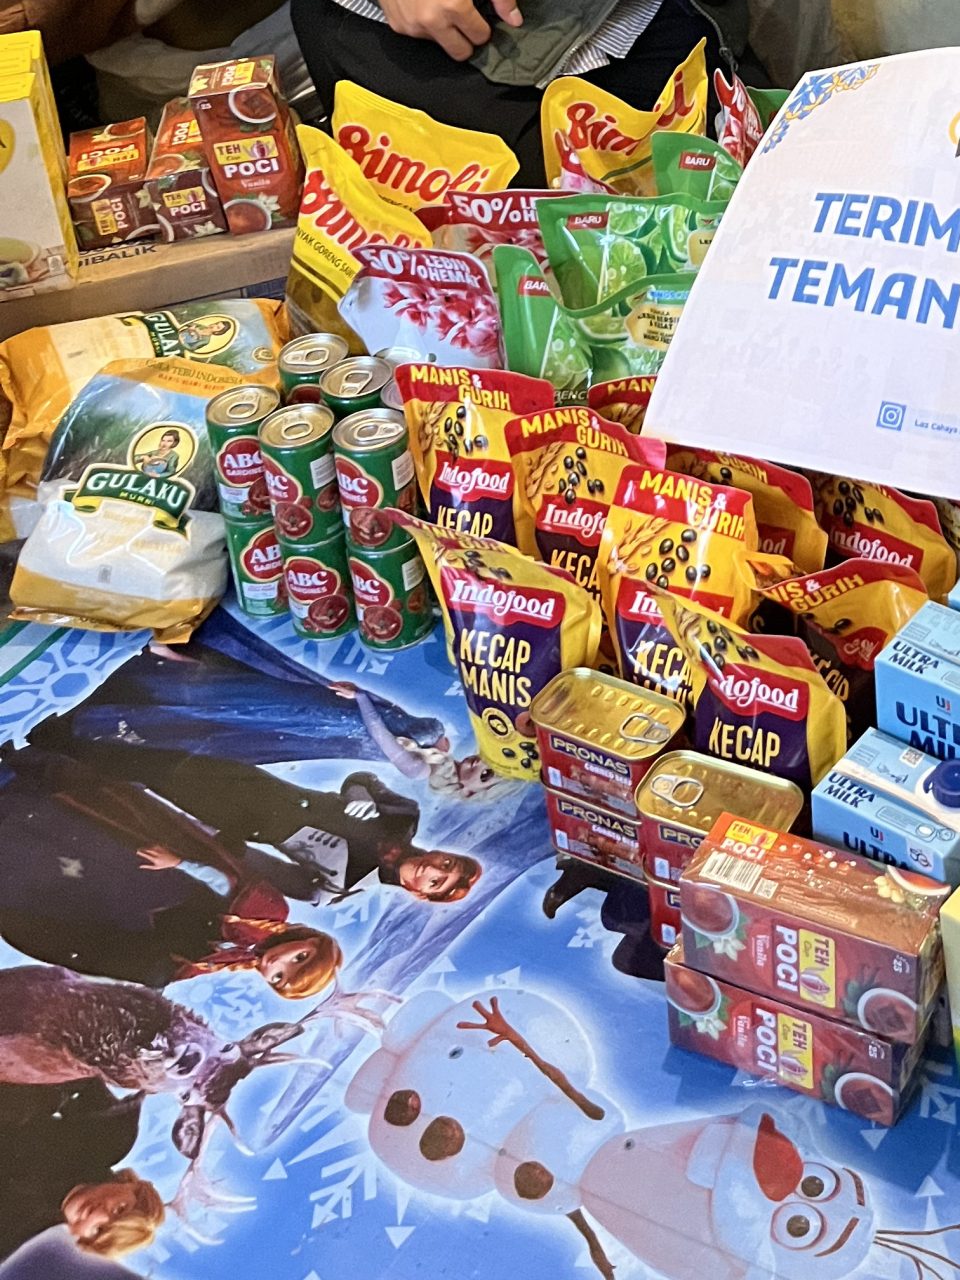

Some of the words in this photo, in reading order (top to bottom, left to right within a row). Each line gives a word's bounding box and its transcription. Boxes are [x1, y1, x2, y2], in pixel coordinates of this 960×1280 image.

[172, 121, 190, 145] POCI
[81, 144, 135, 160] POCI
[216, 143, 241, 156] TEH
[338, 125, 490, 203] Bimoli
[684, 154, 711, 166] BARU
[224, 158, 279, 178] POCI
[111, 198, 128, 229] POCI
[165, 194, 182, 203] TEH
[170, 202, 206, 217] POCI
[452, 192, 522, 224] 50%
[573, 215, 602, 226] BARU
[313, 241, 342, 269] GORENG
[361, 248, 428, 279] 50%
[424, 253, 470, 272] LEBIH
[424, 266, 482, 288] HEMAT
[144, 313, 181, 356] GULA
[409, 365, 470, 385] MANIS
[472, 373, 482, 389] &
[607, 378, 655, 396] MAN
[458, 383, 511, 411] GURIH
[521, 409, 591, 438] MANIS
[591, 416, 600, 429] &
[576, 426, 629, 458] GURIH
[86, 472, 187, 508] GULAKU
[438, 461, 510, 495] Indofood
[640, 470, 712, 507] MANIS
[713, 492, 727, 510] &
[437, 505, 493, 538] KECAP
[543, 504, 607, 540] Indofo
[690, 506, 746, 541] GURIH
[250, 543, 281, 563] AB
[551, 549, 601, 588] KECA
[287, 569, 328, 587] ABC
[354, 574, 381, 594] BC
[766, 580, 801, 601] NIS
[804, 578, 822, 593] &
[789, 573, 865, 611] GURIH
[450, 579, 556, 619] Indofood
[460, 628, 531, 674] KECAP
[635, 639, 694, 686] KECA
[888, 652, 926, 675] MILK
[892, 640, 940, 670] ULTRA
[461, 663, 532, 708] MANIS
[714, 673, 799, 712] dofood
[552, 737, 629, 776] PRONAS
[709, 715, 781, 769] KECAP
[822, 783, 862, 809] MILK
[827, 771, 877, 804] ULTRA
[561, 801, 636, 838] PRONAS
[729, 821, 751, 836] TEH
[720, 837, 766, 860] POCI
[776, 924, 799, 994] POCI
[814, 937, 832, 968] TEH
[755, 1008, 778, 1072] POCI
[791, 1020, 808, 1051] TEH
